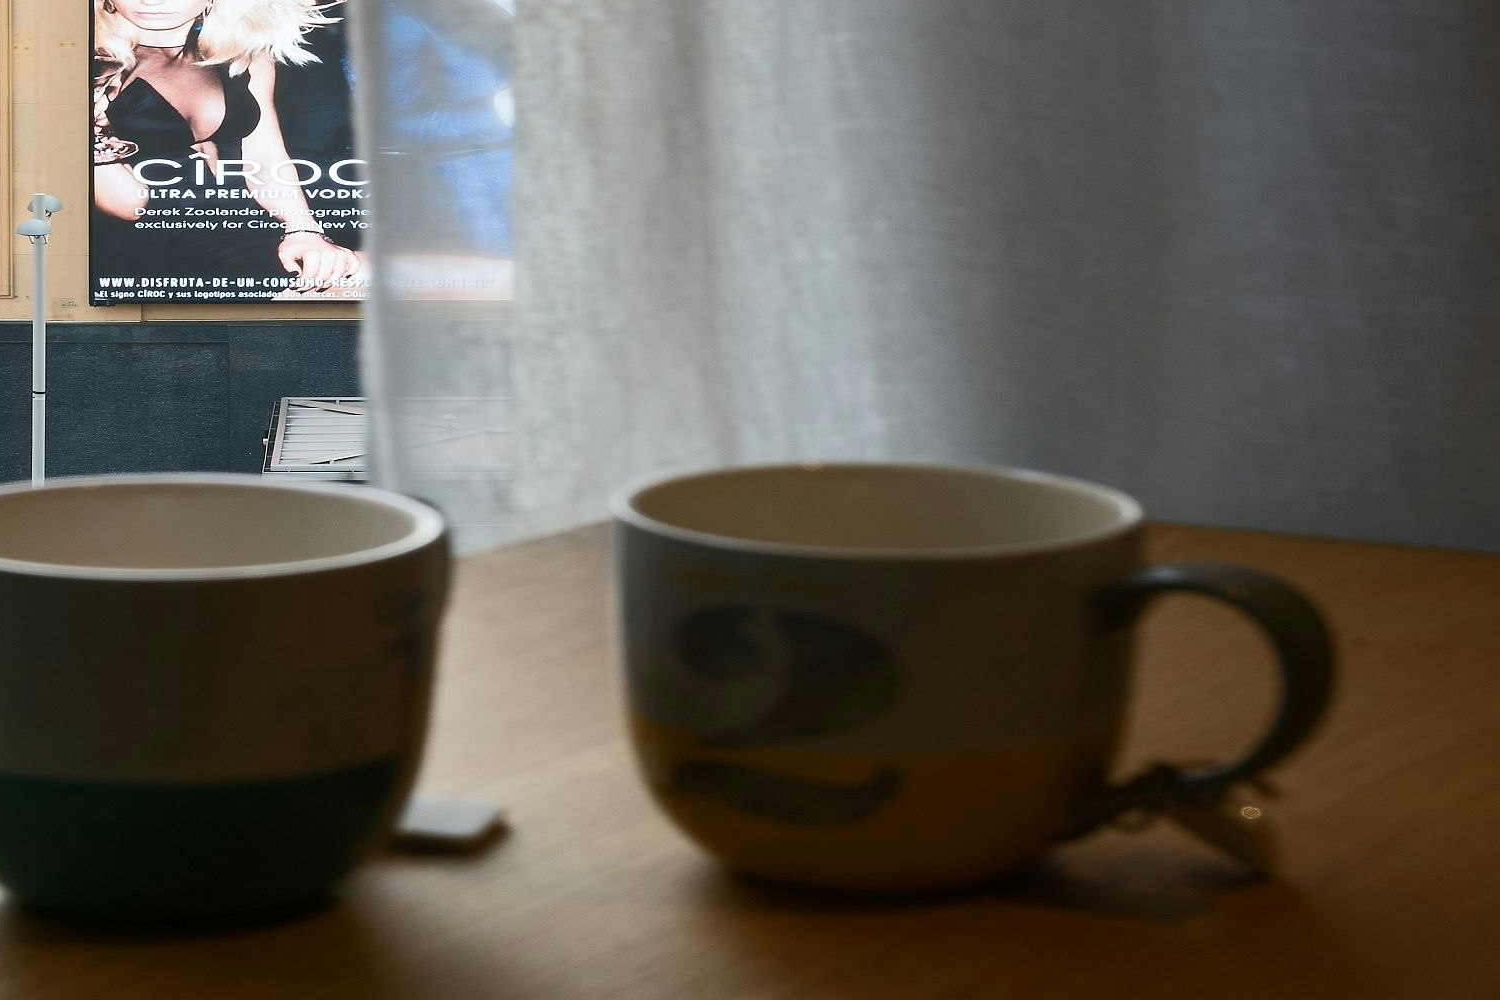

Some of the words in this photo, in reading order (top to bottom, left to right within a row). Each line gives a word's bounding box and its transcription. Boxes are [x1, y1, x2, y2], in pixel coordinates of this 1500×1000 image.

[136, 188, 197, 199] ULTRA
[205, 188, 298, 199] PREMIUM
[134, 207, 180, 217] Derek
[184, 207, 265, 217] Zoolander
[134, 219, 218, 230] exclusively
[222, 219, 243, 229] for
[311, 220, 346, 229] New
[110, 290, 135, 299] signo
[168, 291, 175, 299] y
[194, 290, 236, 299] logotipos
[238, 290, 281, 298] asociados
